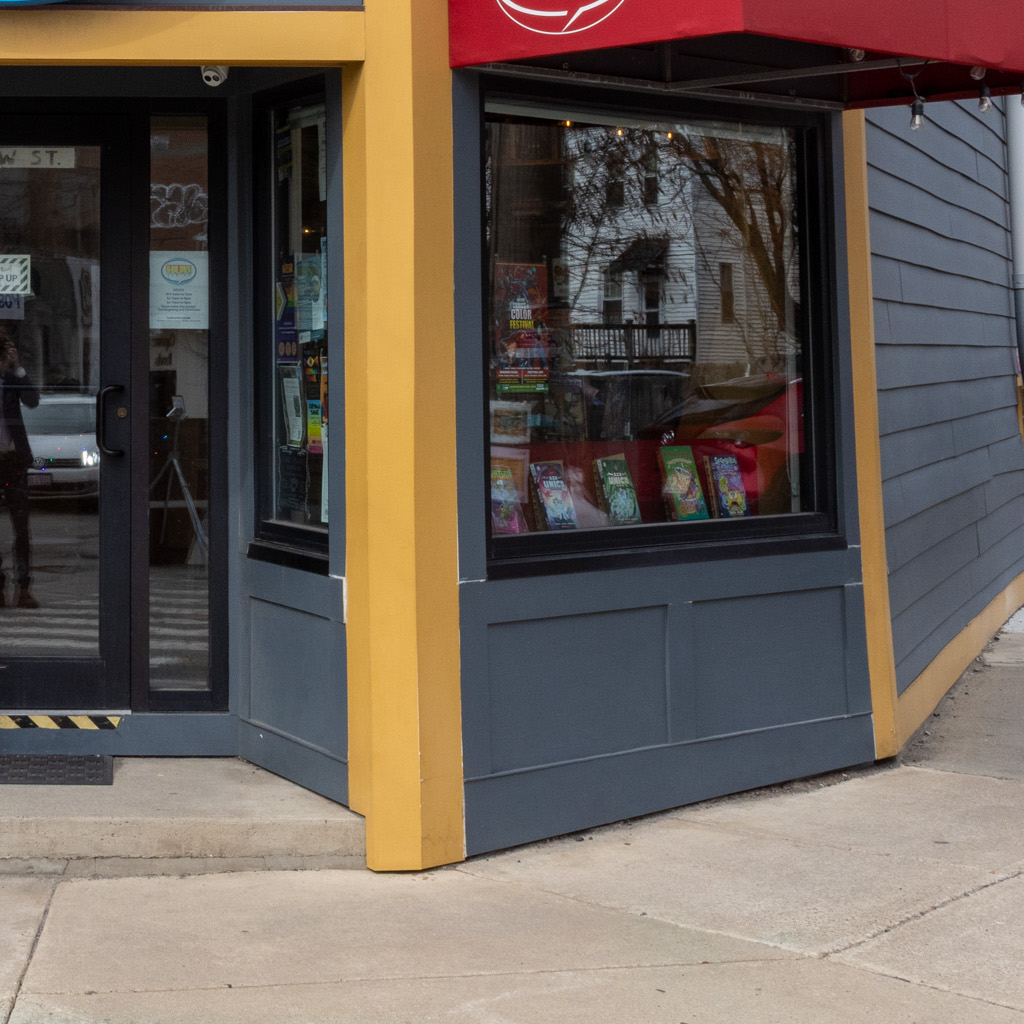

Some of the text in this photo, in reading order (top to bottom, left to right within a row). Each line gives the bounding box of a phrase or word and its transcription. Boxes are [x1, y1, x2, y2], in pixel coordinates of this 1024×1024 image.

[30, 150, 61, 166] ST.
[5, 274, 18, 282] UP
[510, 308, 532, 320] COLOR
[509, 319, 534, 330] FESTIVAL
